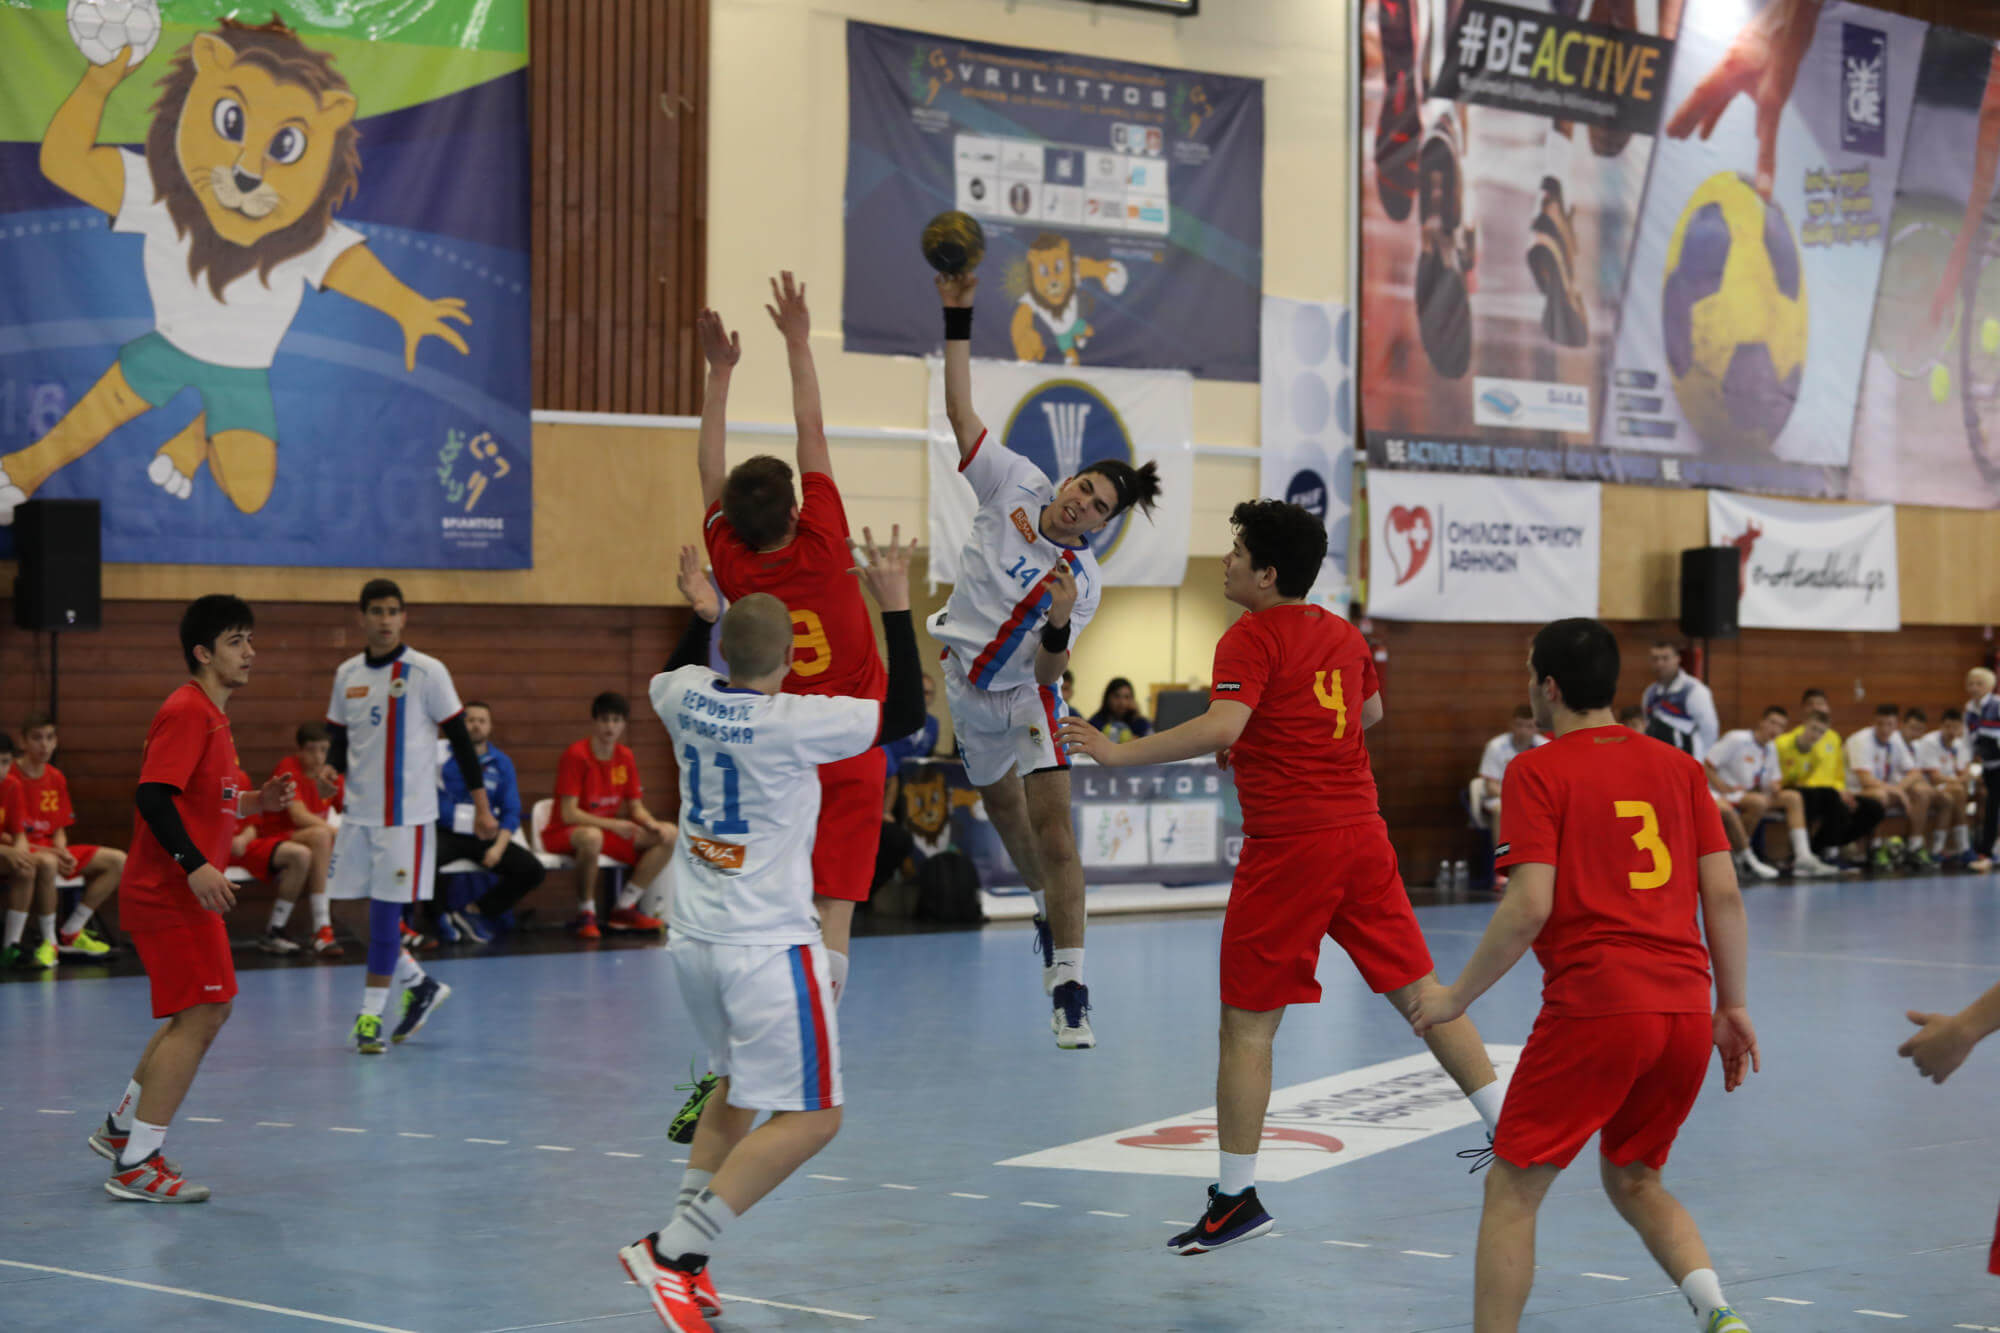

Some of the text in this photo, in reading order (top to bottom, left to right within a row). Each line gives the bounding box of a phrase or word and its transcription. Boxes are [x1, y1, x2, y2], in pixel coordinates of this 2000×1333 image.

[1458, 12, 1660, 99] #BEACTIVE
[959, 64, 1167, 108] VRILITTOS
[1005, 555, 1041, 589] 14
[370, 706, 382, 726] 5
[1313, 669, 1347, 739] 4
[684, 744, 749, 834] 11
[1084, 775, 1219, 797] LITTOS
[1614, 800, 1672, 889] 3
